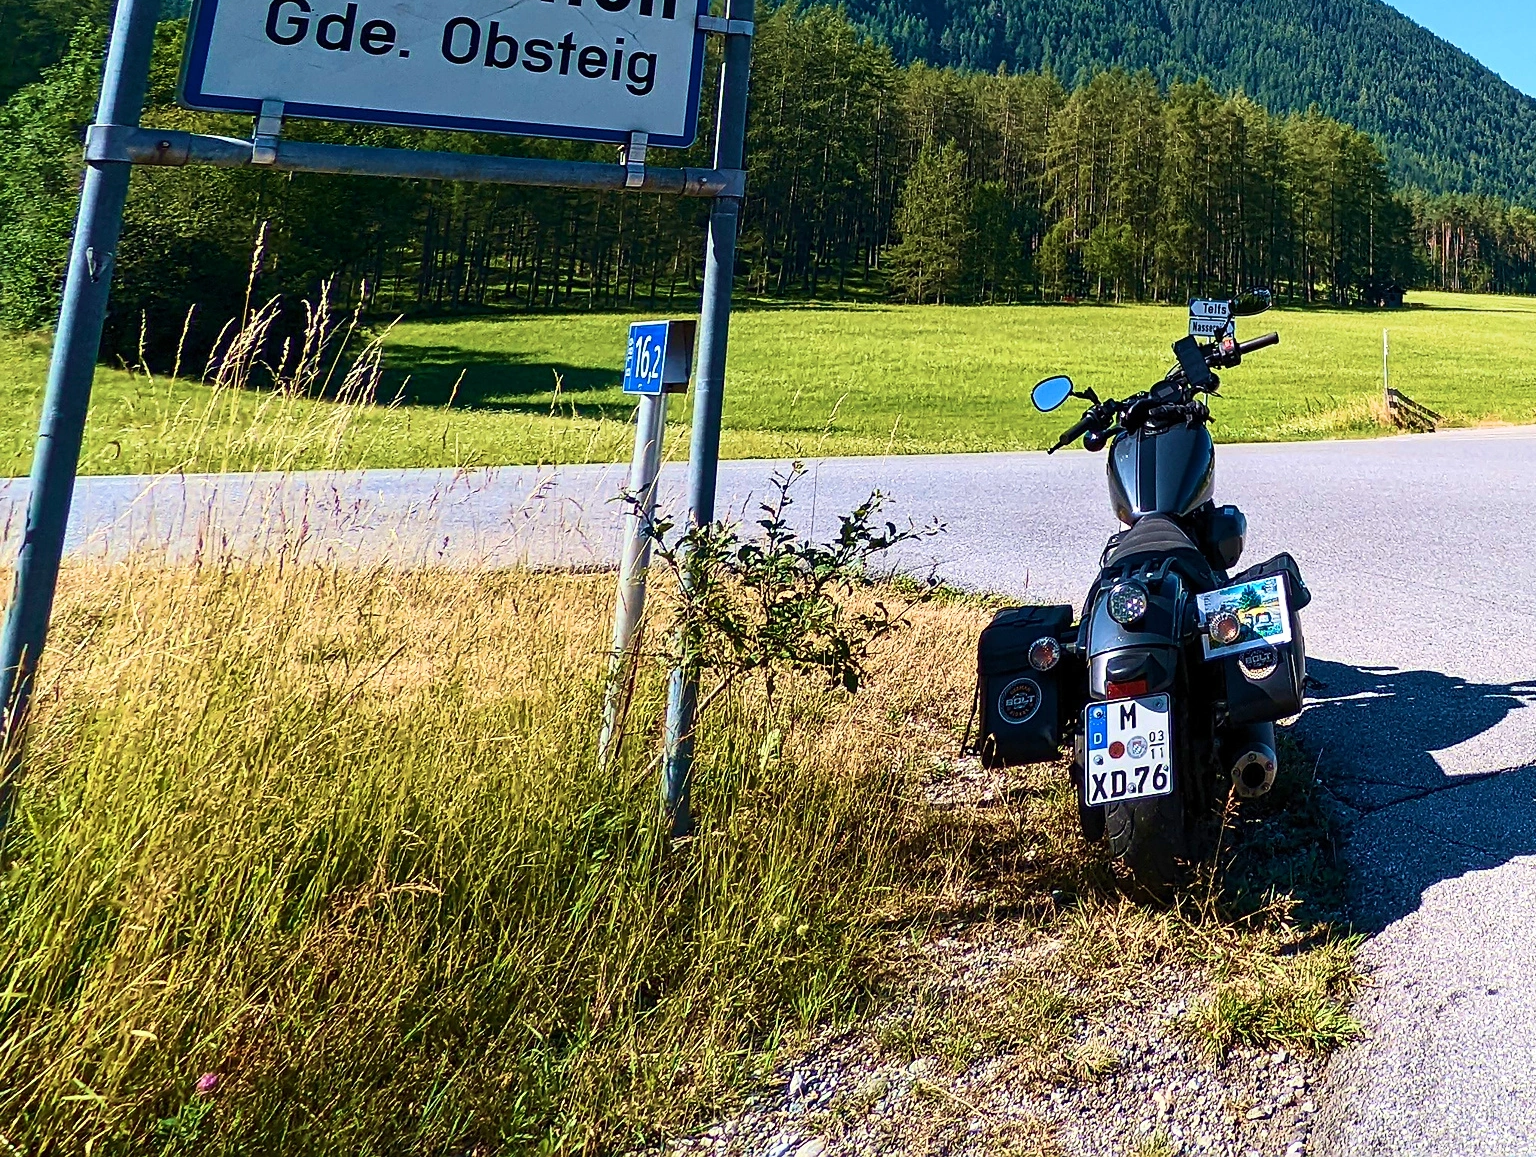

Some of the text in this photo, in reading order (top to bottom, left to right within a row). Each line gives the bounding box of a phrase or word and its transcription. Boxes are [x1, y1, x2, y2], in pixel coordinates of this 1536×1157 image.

[441, 16, 658, 97] Obsteig
[1203, 303, 1227, 315] Telfs
[636, 335, 661, 384] 16,2
[1006, 695, 1035, 706] BOLT
[1120, 703, 1136, 730] M
[1093, 733, 1103, 744] D
[1149, 730, 1164, 742] 03
[1150, 748, 1164, 759] 11
[1092, 764, 1167, 801] XD 76
